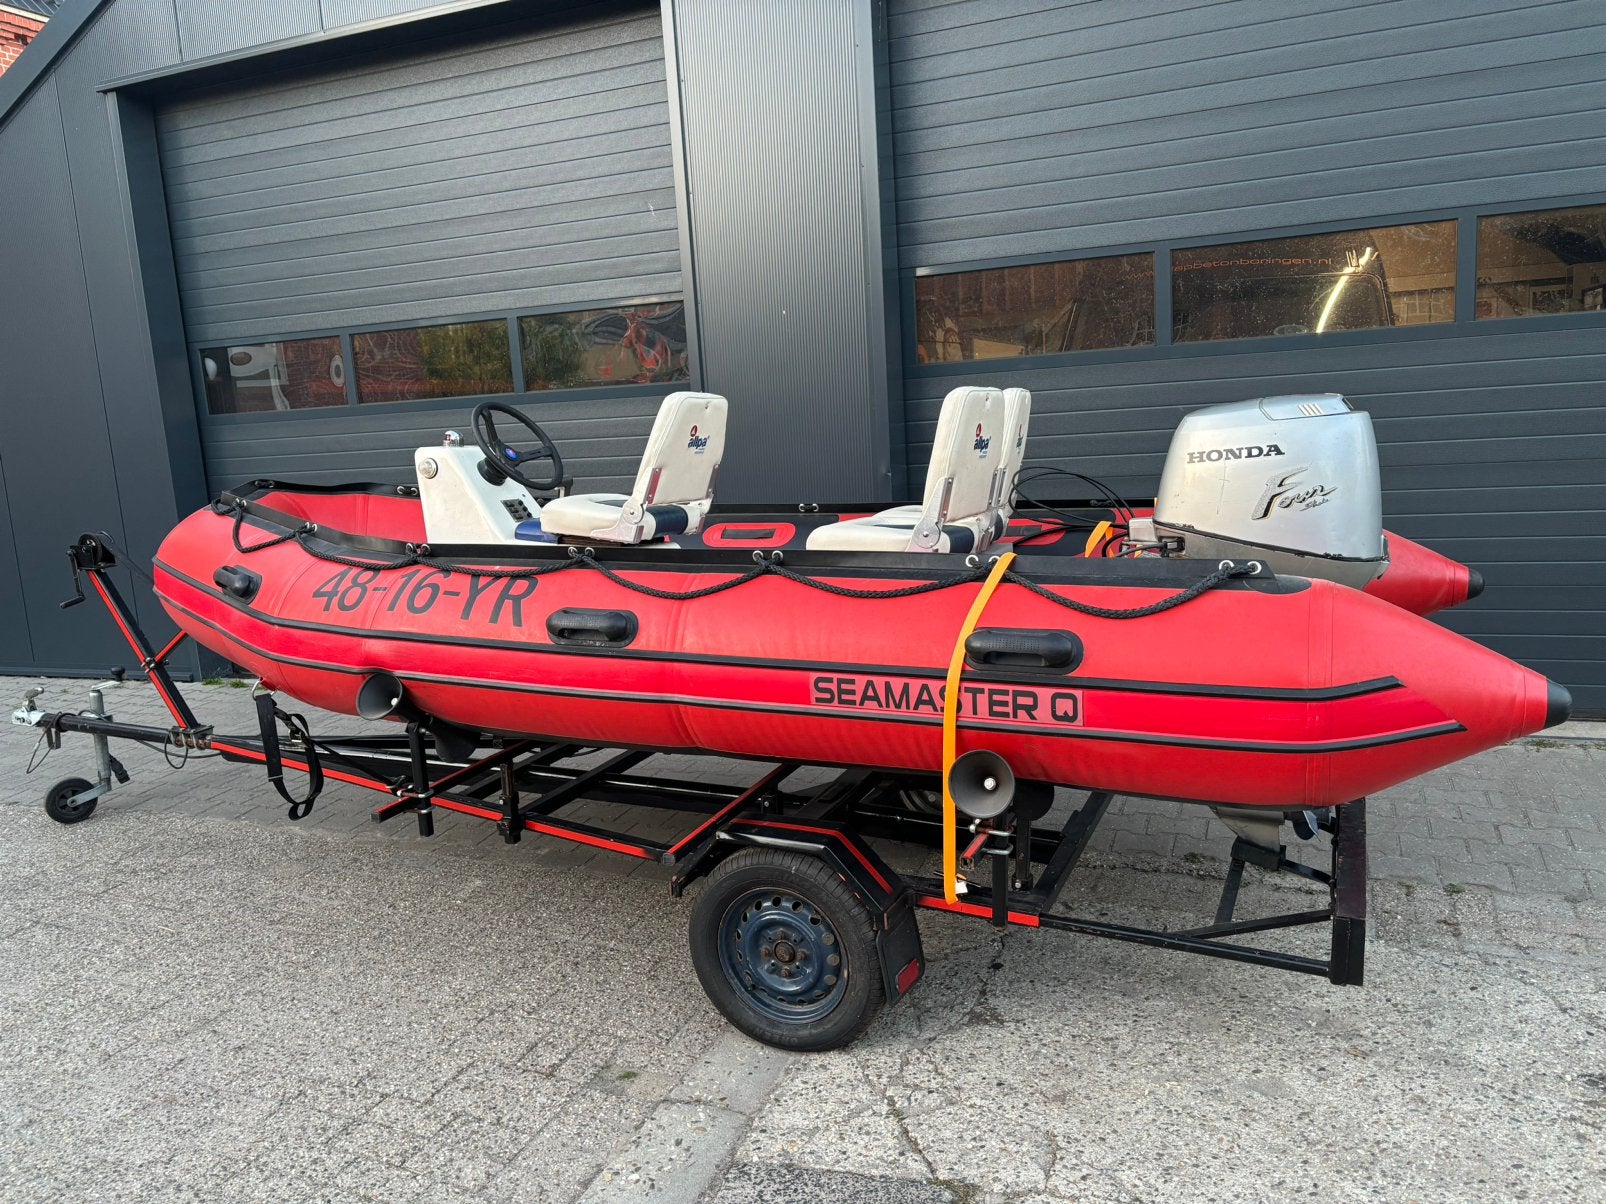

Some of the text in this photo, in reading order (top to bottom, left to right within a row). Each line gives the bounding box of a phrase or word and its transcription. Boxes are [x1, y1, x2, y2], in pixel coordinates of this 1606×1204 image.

[1187, 444, 1286, 464] HONDA
[312, 566, 539, 628] 48-16-YR
[1051, 692, 1079, 723] Q
